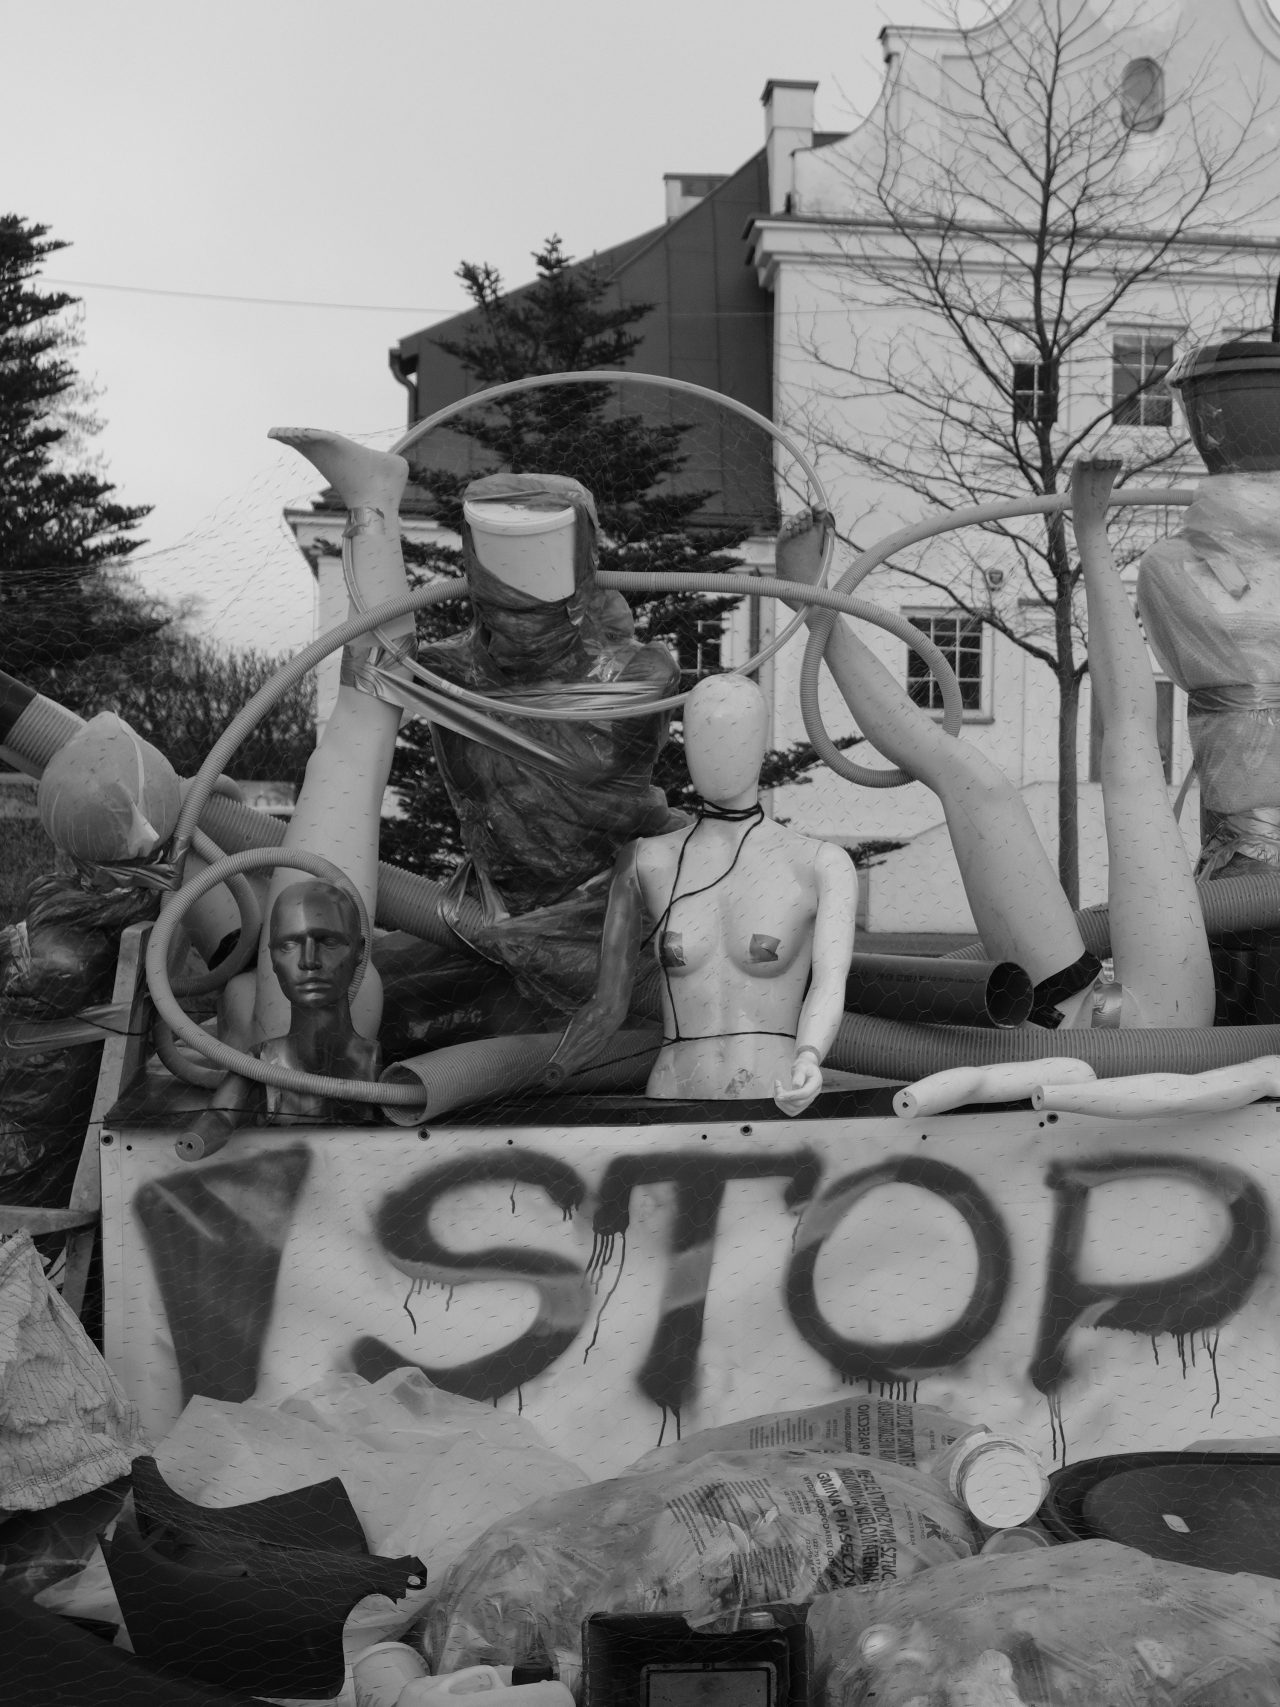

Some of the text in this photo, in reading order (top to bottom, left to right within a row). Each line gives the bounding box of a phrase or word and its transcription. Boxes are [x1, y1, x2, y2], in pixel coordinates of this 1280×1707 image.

[350, 1145, 1274, 1404] STOP
[815, 1498, 834, 1548] GOSPODARKI
[817, 1472, 857, 1587] GMINA PIASECZN
[880, 1546, 898, 1580] SZTUC
